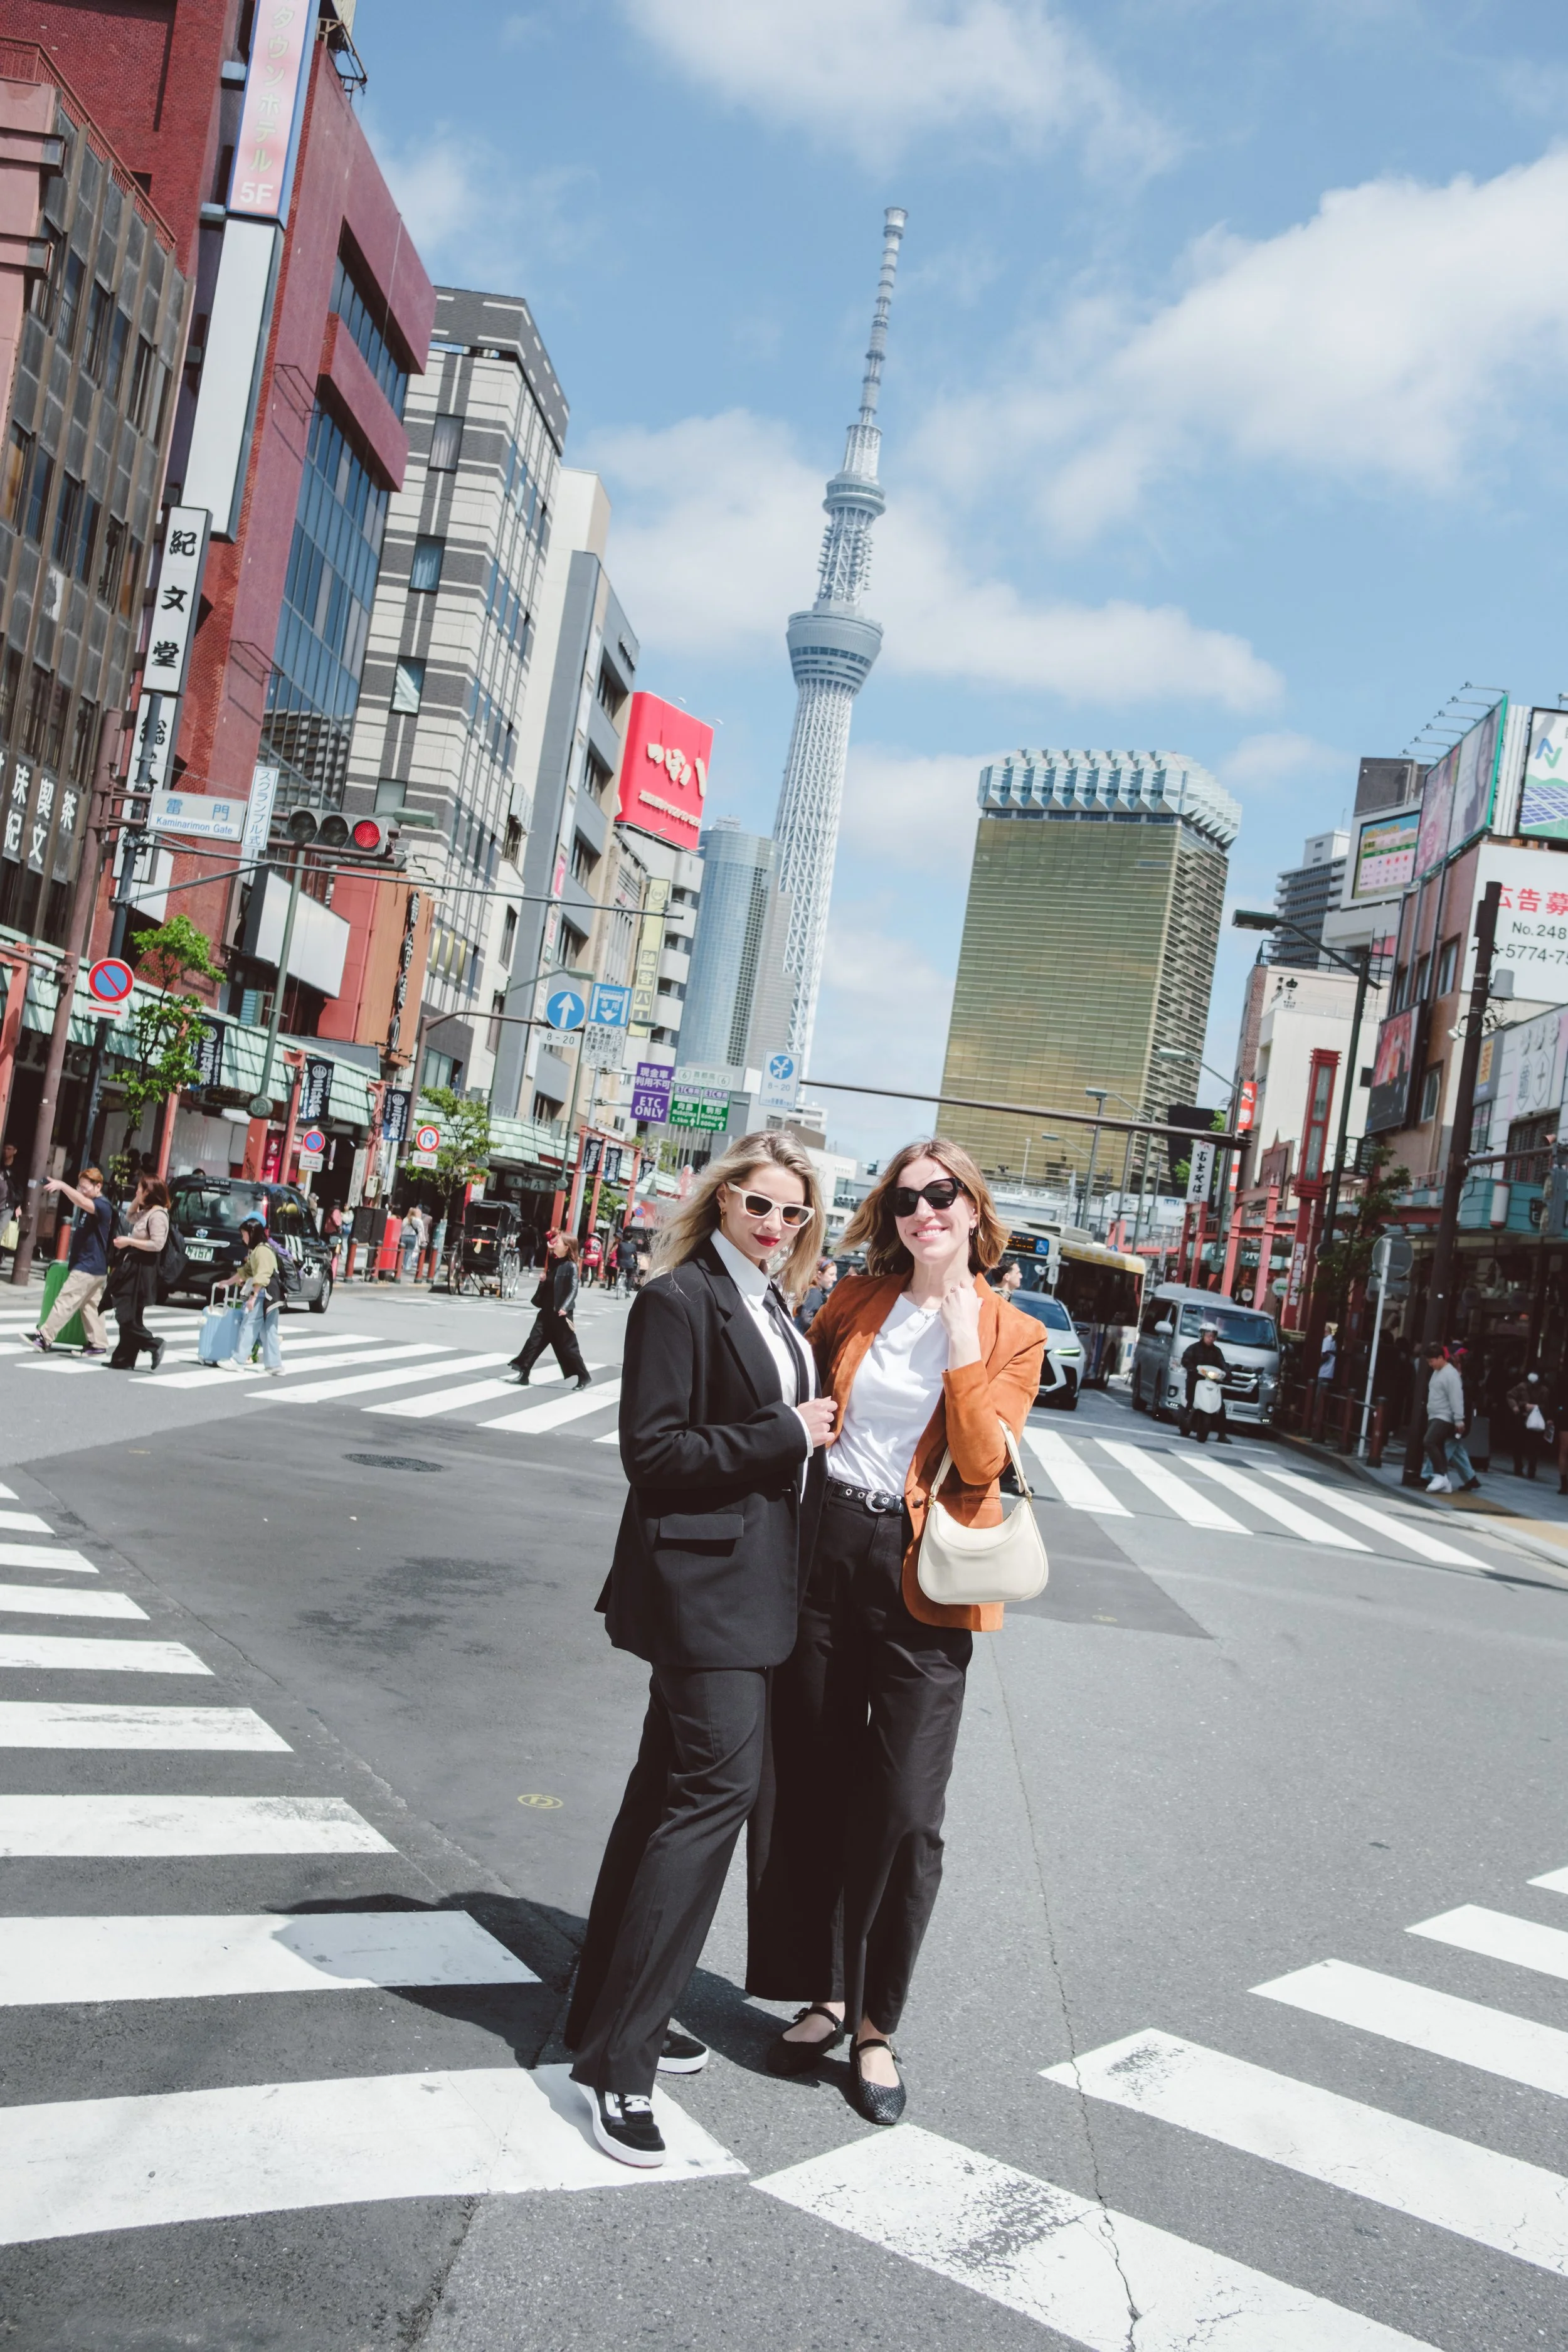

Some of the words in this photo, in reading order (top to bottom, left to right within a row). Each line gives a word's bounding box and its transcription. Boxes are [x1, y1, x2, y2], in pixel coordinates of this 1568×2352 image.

[240, 181, 273, 204] 5F
[151, 530, 197, 669] 紀文堂
[166, 798, 230, 821] 雷門
[249, 771, 271, 845] スクランブル式
[156, 816, 210, 832] Kaminarimon
[213, 824, 233, 835] Gate
[635, 1076, 671, 1090] 利用不可
[640, 1067, 669, 1079] 現金車
[635, 1106, 664, 1118] ONLY
[639, 1096, 662, 1108] ETC
[1193, 1152, 1209, 1193] 富士そば
